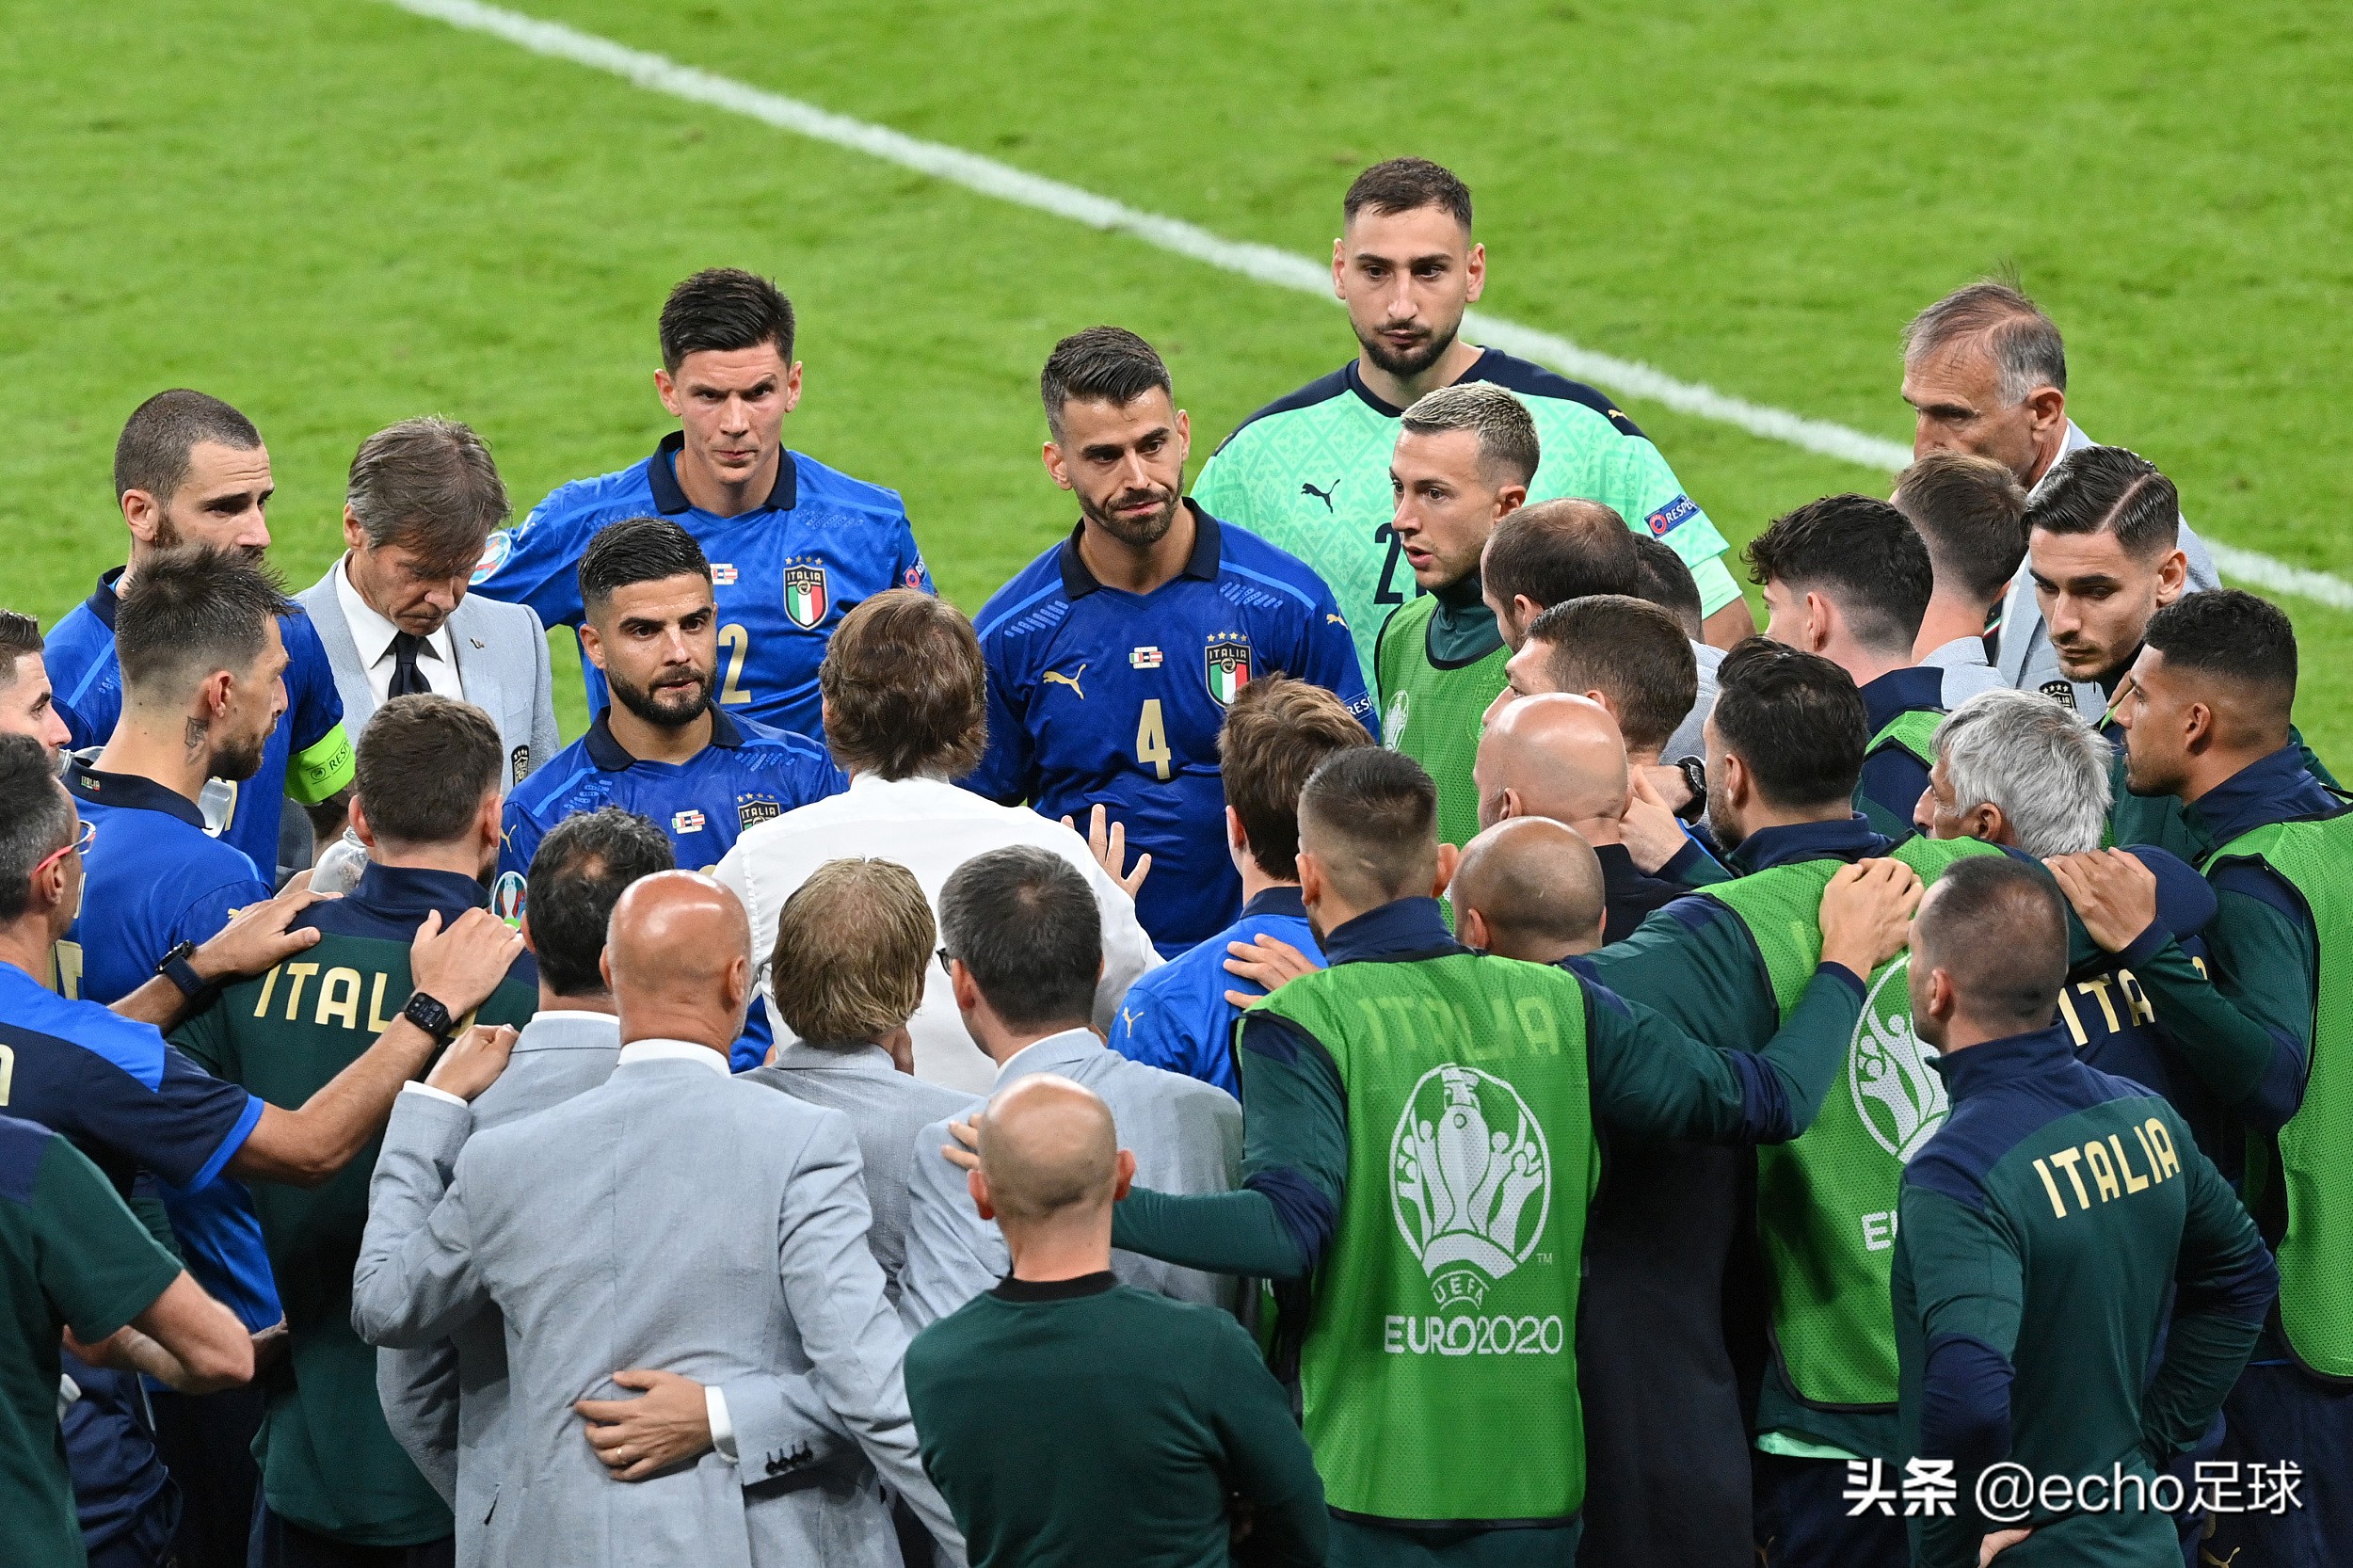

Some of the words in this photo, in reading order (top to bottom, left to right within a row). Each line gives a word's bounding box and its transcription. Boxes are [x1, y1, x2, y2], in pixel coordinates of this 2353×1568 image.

[787, 570, 822, 582] ITALIA
[1209, 648, 1247, 660] ITALIA
[1136, 698, 1172, 780] 4
[741, 807, 776, 820] ITALIA
[1356, 995, 1561, 1063] ITALIA
[2032, 1117, 2181, 1219] ITALIA
[1433, 1276, 1485, 1306] UEFA
[1385, 1314, 1563, 1356] EURO2020
